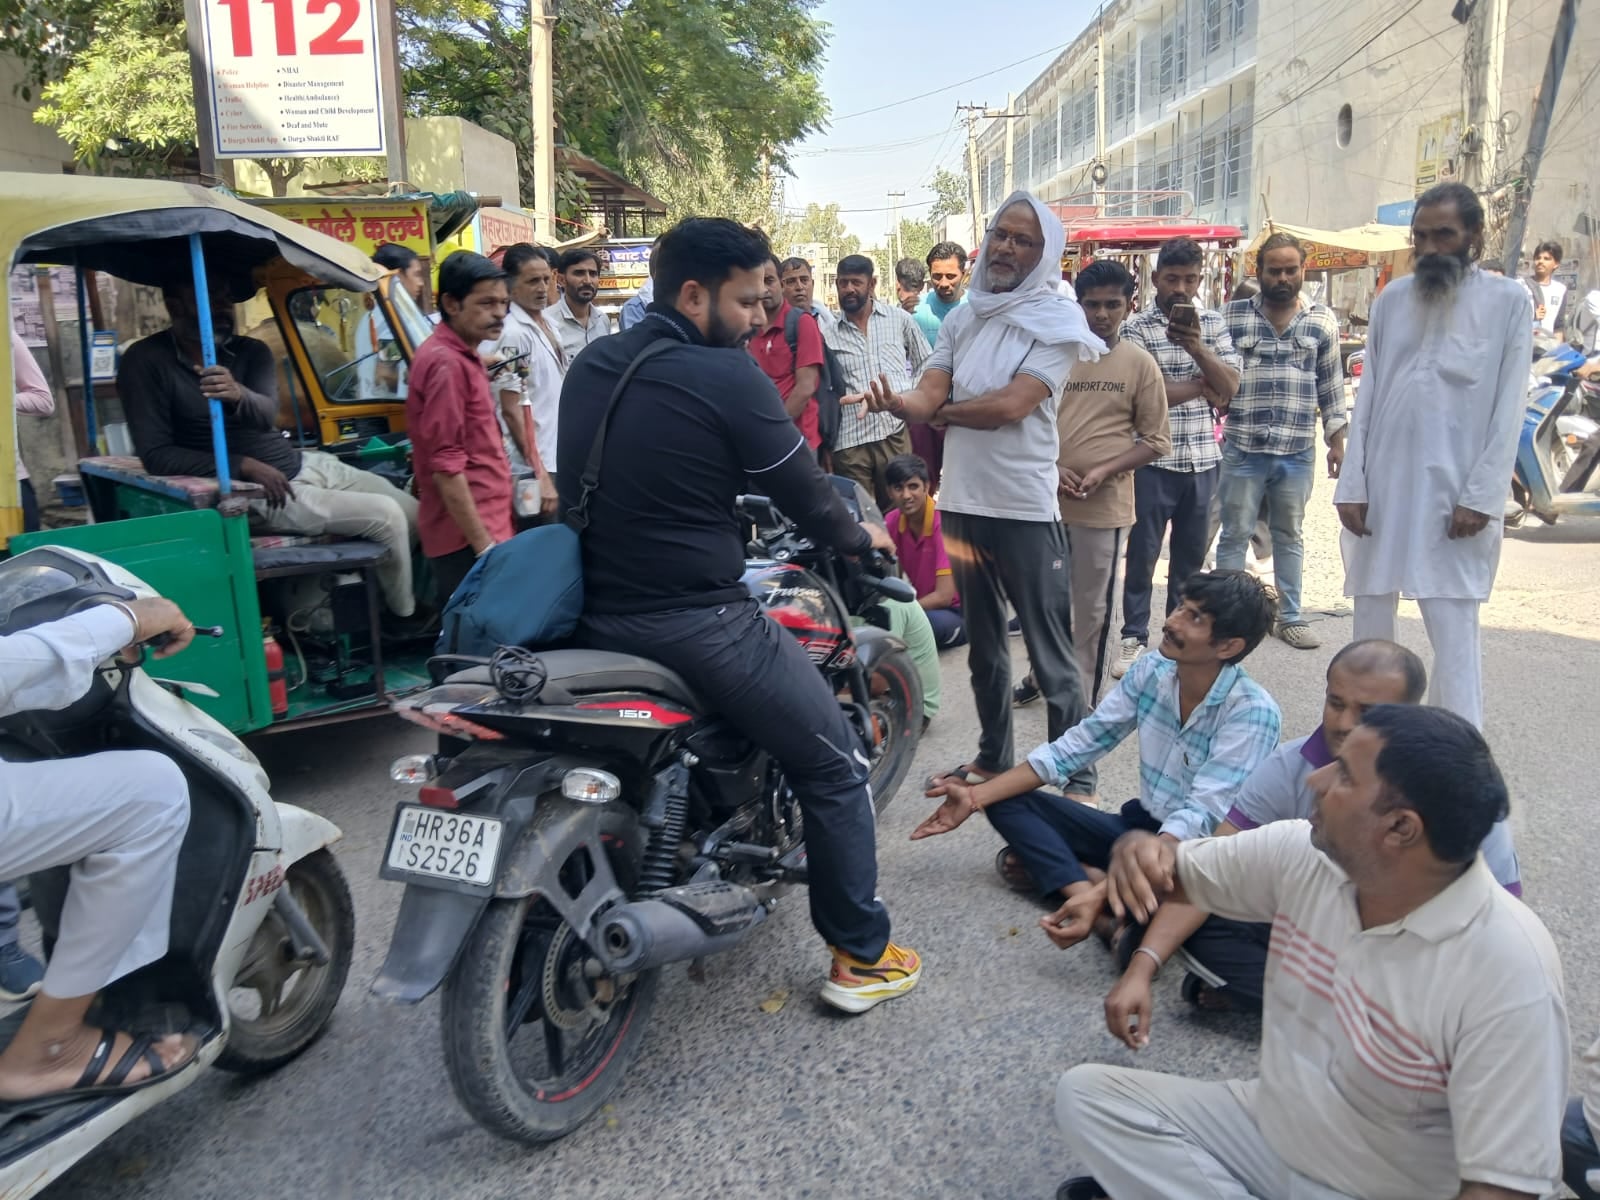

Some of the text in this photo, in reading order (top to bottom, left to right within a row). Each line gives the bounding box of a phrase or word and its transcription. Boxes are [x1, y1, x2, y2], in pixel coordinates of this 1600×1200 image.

[217, 0, 365, 57] 112
[307, 80, 345, 88] Management
[337, 107, 375, 116] Development
[1065, 382, 1126, 392] OMFORT ZONE
[618, 708, 653, 720] 150
[414, 812, 486, 848] HR36A
[400, 833, 413, 842] IND
[406, 842, 480, 877] S2526
